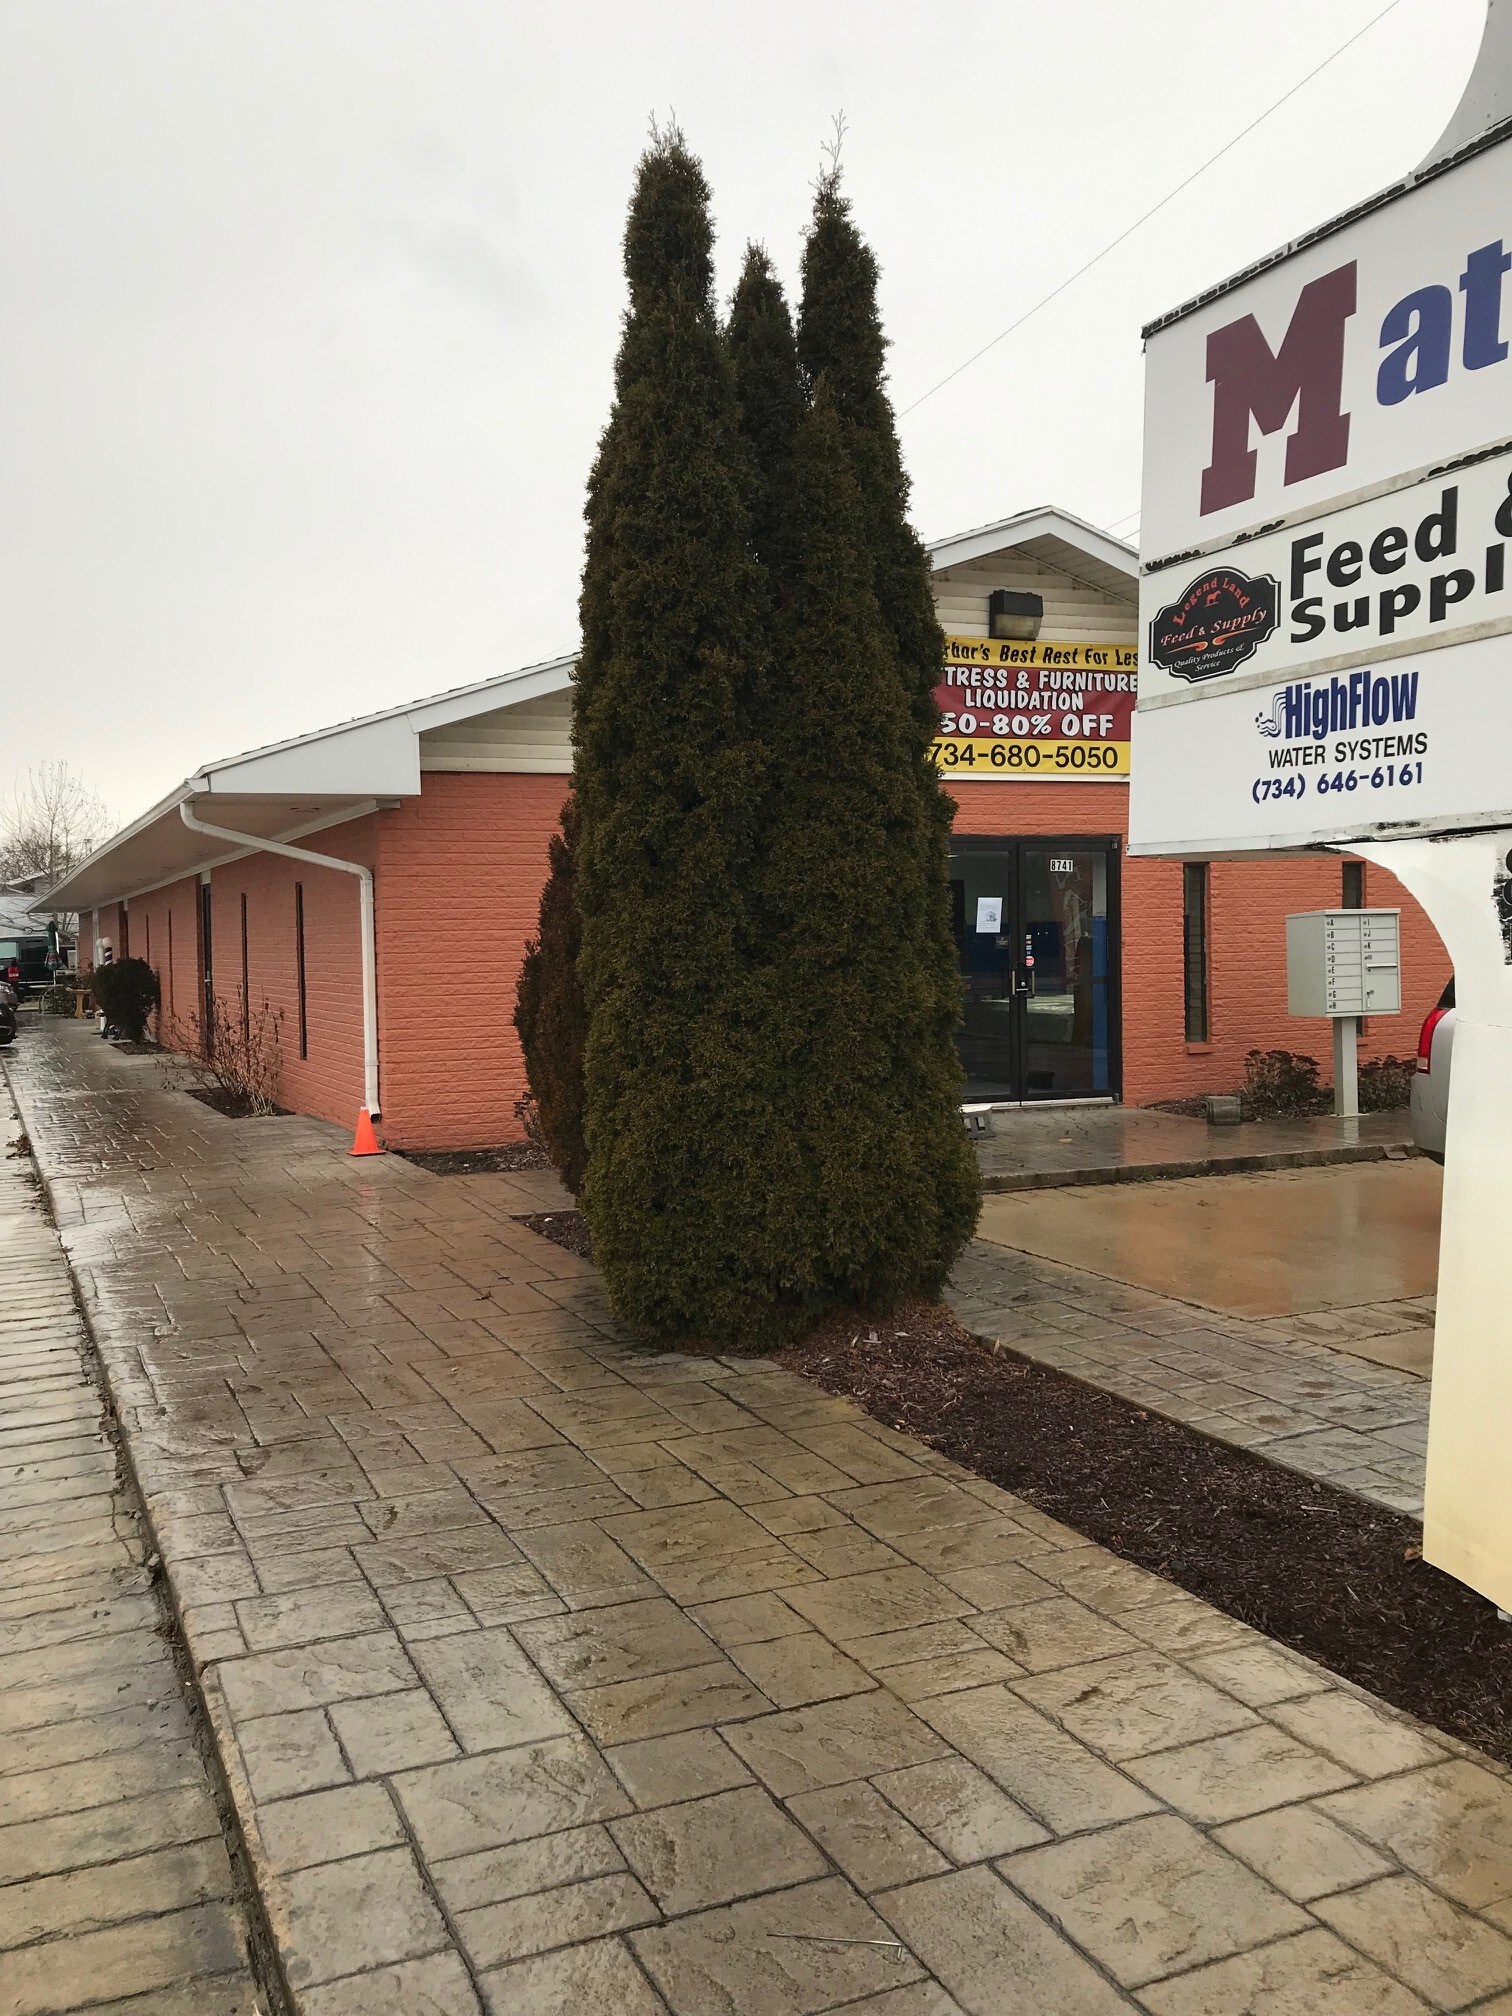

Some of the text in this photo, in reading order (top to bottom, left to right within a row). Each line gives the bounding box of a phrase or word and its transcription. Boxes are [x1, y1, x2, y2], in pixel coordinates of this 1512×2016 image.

[1200, 238, 1512, 517] Mat
[1290, 485, 1459, 601] Feed
[1172, 576, 1251, 626] Legend Land
[1290, 542, 1505, 643] Suppl
[1160, 606, 1267, 646] Feed & Supply
[1000, 644, 1037, 664] Best
[1042, 646, 1078, 664] Rest
[1084, 648, 1108, 665] For
[1174, 655, 1201, 669] Quality
[1202, 647, 1234, 661] Products
[1195, 660, 1221, 672] Service
[944, 666, 1138, 692] TRESS & FURNITURE
[965, 688, 1084, 712] LIQUIDATION
[1285, 670, 1419, 740] HighFlow
[941, 712, 1114, 737] 50-80% OFF
[929, 742, 1118, 769] 734-680-5050
[1269, 732, 1428, 769] WATER SYSTEMS
[1252, 762, 1423, 804] (734) 646-6161
[1051, 860, 1072, 871] 8741
